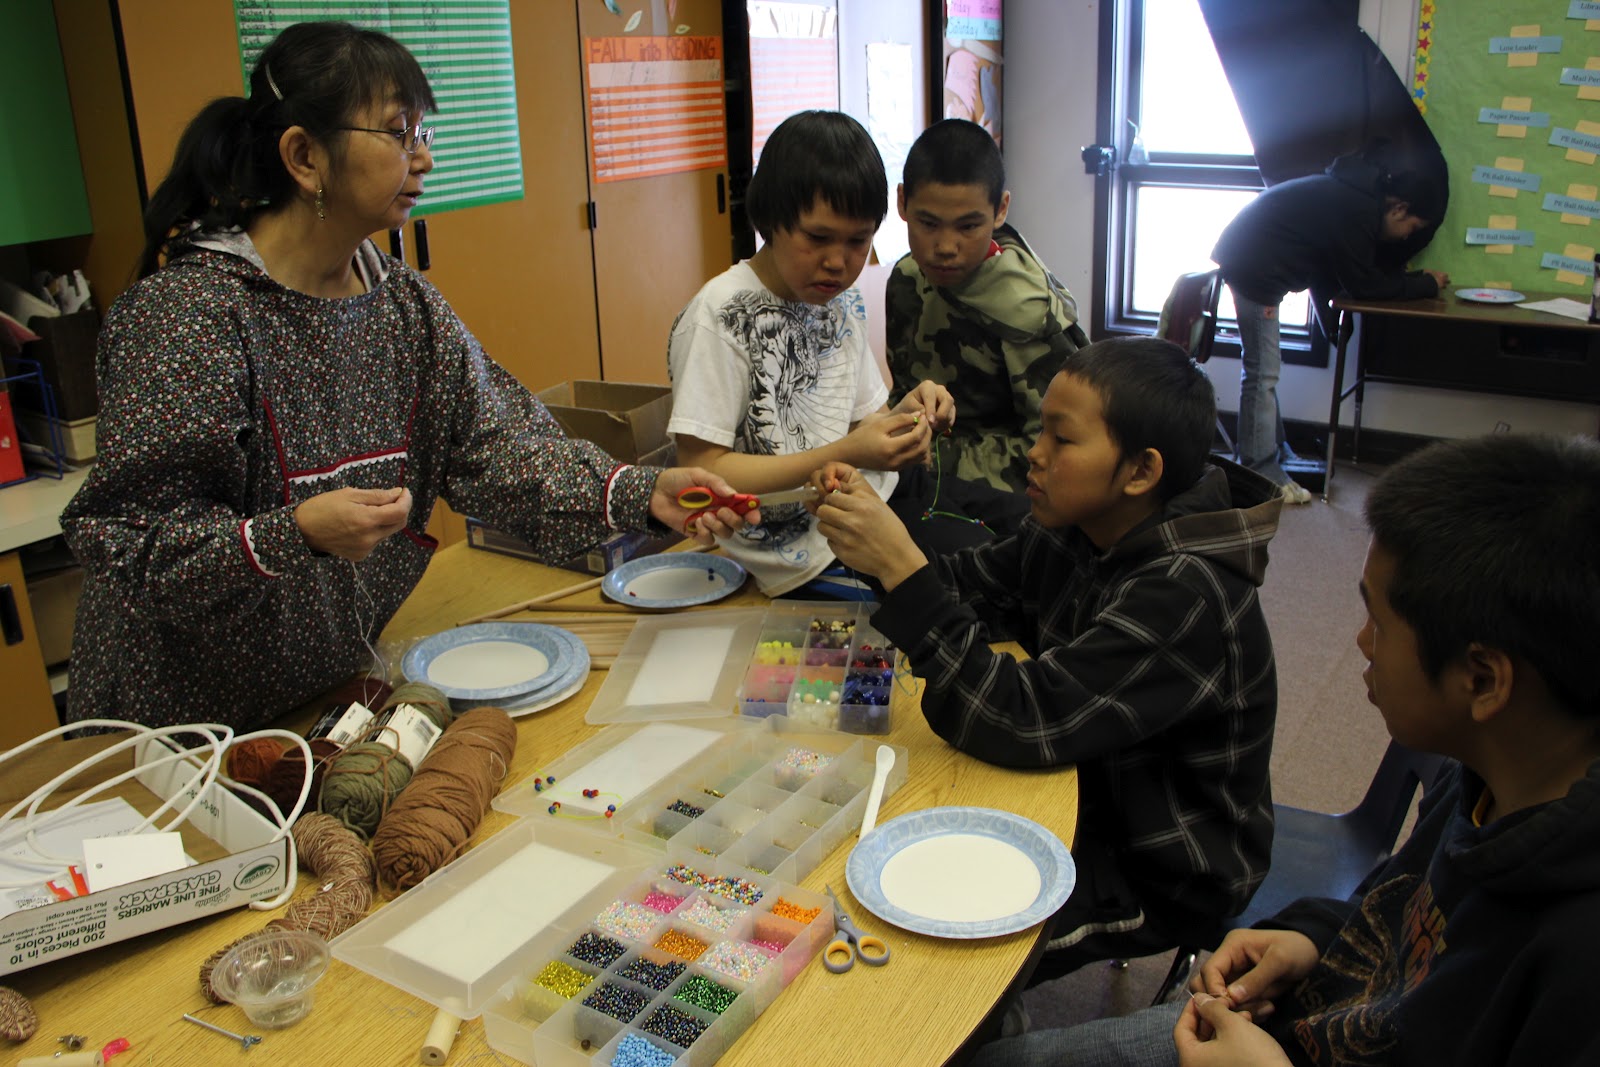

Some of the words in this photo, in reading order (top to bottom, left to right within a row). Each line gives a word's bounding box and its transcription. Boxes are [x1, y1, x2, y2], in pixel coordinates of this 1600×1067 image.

[590, 37, 632, 63] FALL
[639, 36, 662, 61] into
[665, 36, 717, 60] READING
[1571, 74, 1588, 82] Mail
[1488, 112, 1508, 120] Paper
[1560, 135, 1570, 143] PE
[1504, 175, 1526, 184] Holder
[1553, 199, 1563, 207] PE
[1563, 201, 1577, 209] Ball
[1476, 232, 1486, 240] PE
[1551, 259, 1560, 267] PE
[244, 866, 273, 885] Crayola
[119, 869, 222, 910] CLASSPACK
[199, 883, 221, 898] FINE
[173, 889, 196, 905] LINE
[94, 901, 108, 909] Plus
[117, 898, 171, 921] MARKERS
[66, 907, 84, 916] extra
[56, 919, 107, 941] Different
[83, 930, 106, 944] 200
[14, 935, 54, 952] Colors
[42, 937, 80, 955] Pieces
[10, 954, 24, 966] 10
[27, 949, 39, 959] in
